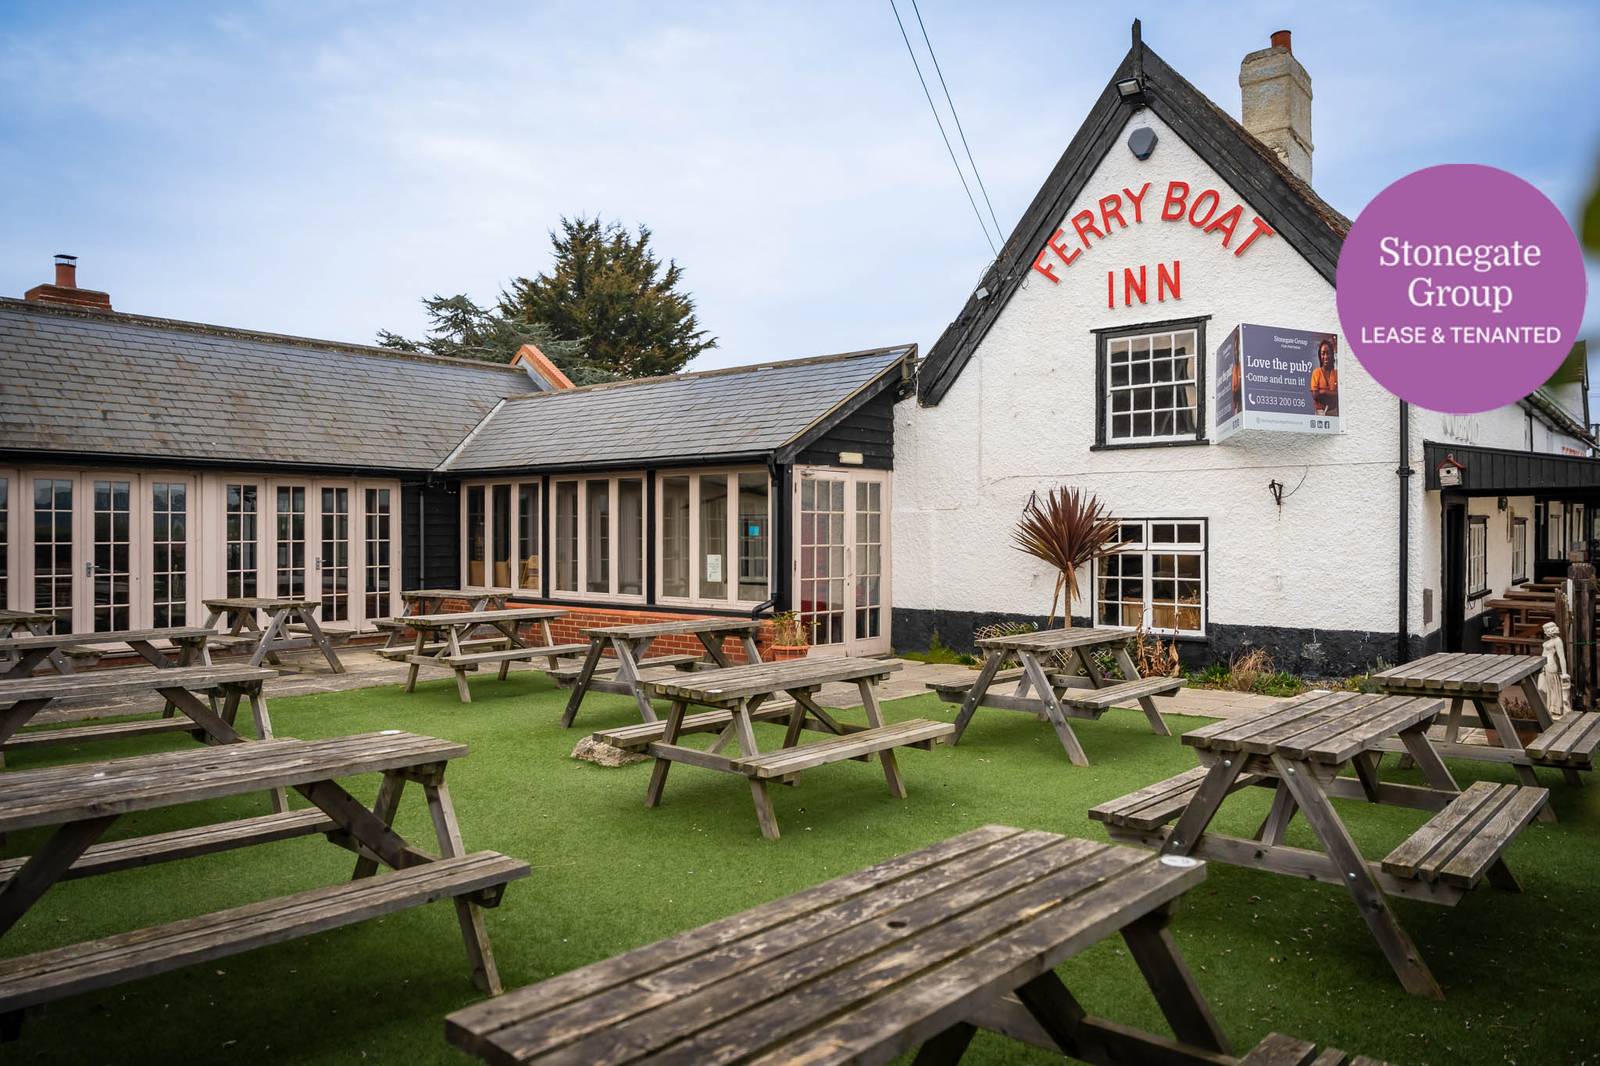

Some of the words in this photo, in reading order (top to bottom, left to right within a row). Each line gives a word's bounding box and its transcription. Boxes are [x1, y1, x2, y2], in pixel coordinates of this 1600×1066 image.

[1033, 182, 1150, 285] FERRY
[1161, 181, 1275, 257] BOAT
[1108, 261, 1181, 309] INN
[1247, 355, 1271, 369] Love
[1272, 357, 1288, 370] the
[1290, 360, 1313, 374] pub?
[1247, 372, 1268, 383] Come
[1269, 374, 1283, 385] and
[1284, 377, 1297, 385] run
[1298, 377, 1306, 386] it!
[1256, 395, 1278, 405] 03333
[1279, 397, 1291, 407] 200
[1293, 398, 1306, 408] 036
